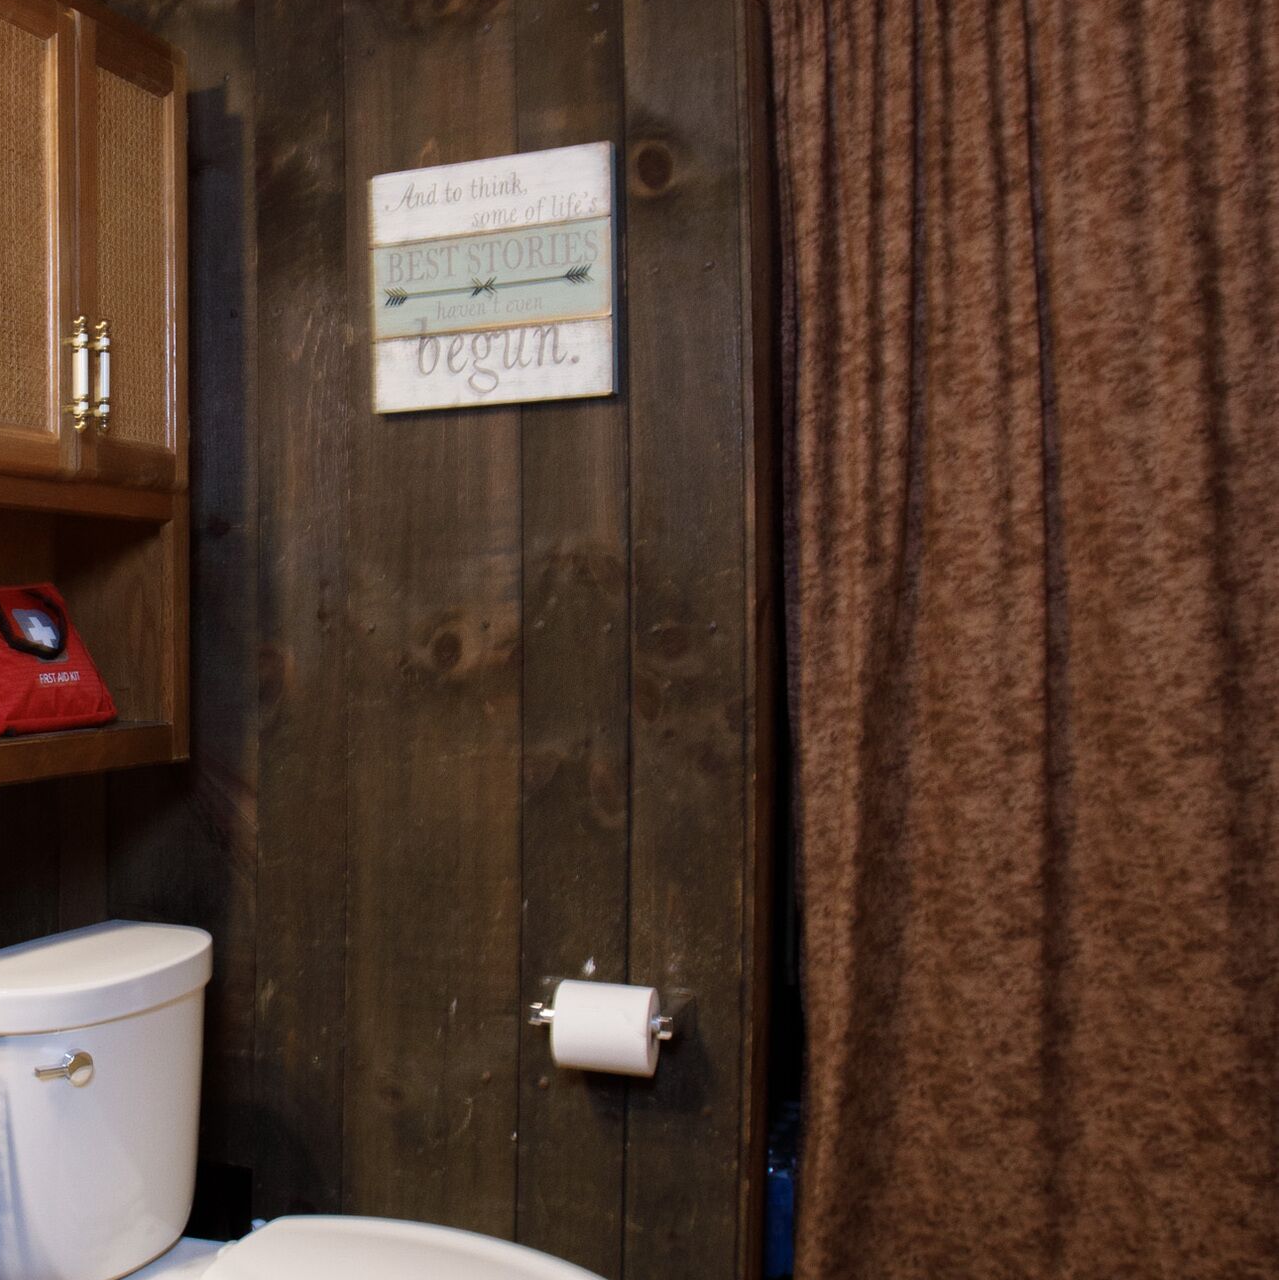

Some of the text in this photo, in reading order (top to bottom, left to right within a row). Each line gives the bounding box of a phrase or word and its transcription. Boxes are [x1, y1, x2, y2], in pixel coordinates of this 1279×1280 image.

[384, 171, 528, 212] And to think,
[471, 191, 599, 228] some of life's
[387, 228, 599, 285] BEST STORIES
[436, 296, 543, 320] haven't even
[414, 316, 580, 394] begun.
[57, 671, 70, 682] AID
[70, 671, 80, 681] KIT
